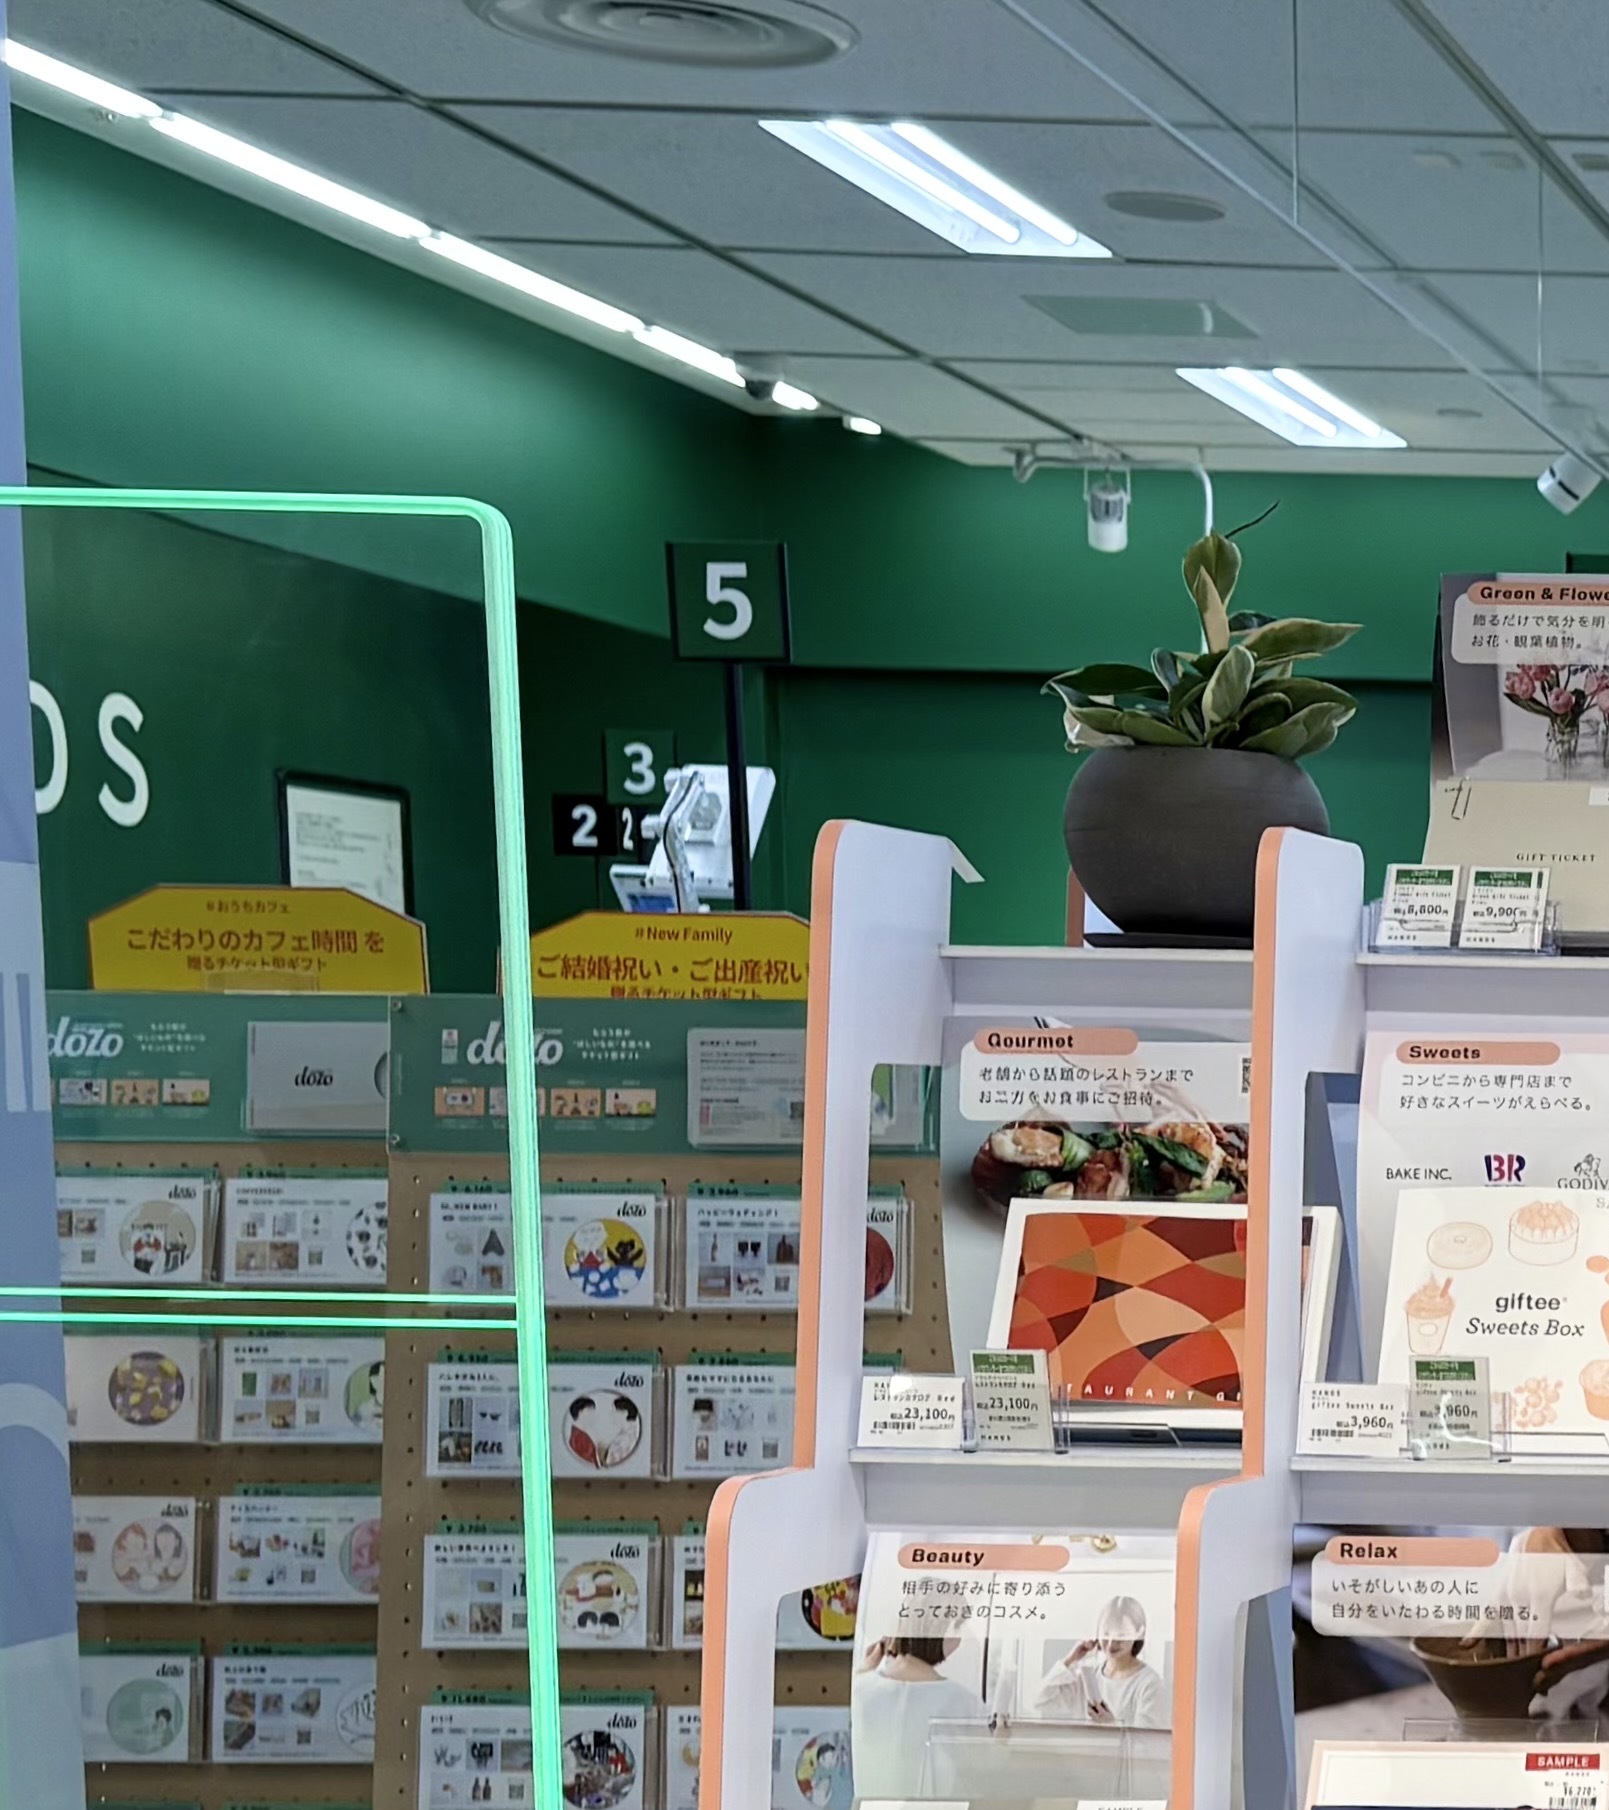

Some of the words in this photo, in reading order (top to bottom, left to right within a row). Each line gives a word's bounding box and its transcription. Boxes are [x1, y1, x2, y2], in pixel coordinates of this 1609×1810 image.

[702, 561, 754, 640] 5
[1480, 585, 1533, 603] Green
[1541, 586, 1554, 603] &
[622, 741, 656, 792] 3
[570, 805, 599, 848] 2
[1516, 852, 1545, 863] GIFT
[1550, 852, 1597, 863] TICKET
[127, 928, 358, 953] こだわりのカフェ時間
[364, 932, 385, 953] を
[682, 927, 733, 945] Family
[987, 1032, 1074, 1050] Gourmet
[1409, 1046, 1481, 1060] Sweets
[1401, 1073, 1573, 1090] コンビニから専門店まで
[1400, 1095, 1592, 1111] 好きなスイーツがえらべる。
[1386, 1167, 1422, 1181] BAKE
[1424, 1167, 1452, 1181] INC.
[1484, 1154, 1526, 1183] BR
[1496, 1293, 1561, 1312] giftee
[1465, 1317, 1540, 1337] Sweets
[1544, 1318, 1586, 1338] Box
[910, 1547, 985, 1568] Beauty
[1339, 1542, 1398, 1560] Relax
[902, 1579, 1067, 1597] 相手の好みに寄り添う
[1331, 1578, 1480, 1596] いそがしいあの人に
[898, 1603, 1047, 1621] とっておきのコスメ。
[1331, 1603, 1541, 1621] 自分をいたわる時間を贈る。
[1537, 1755, 1590, 1769] SAMPLE
